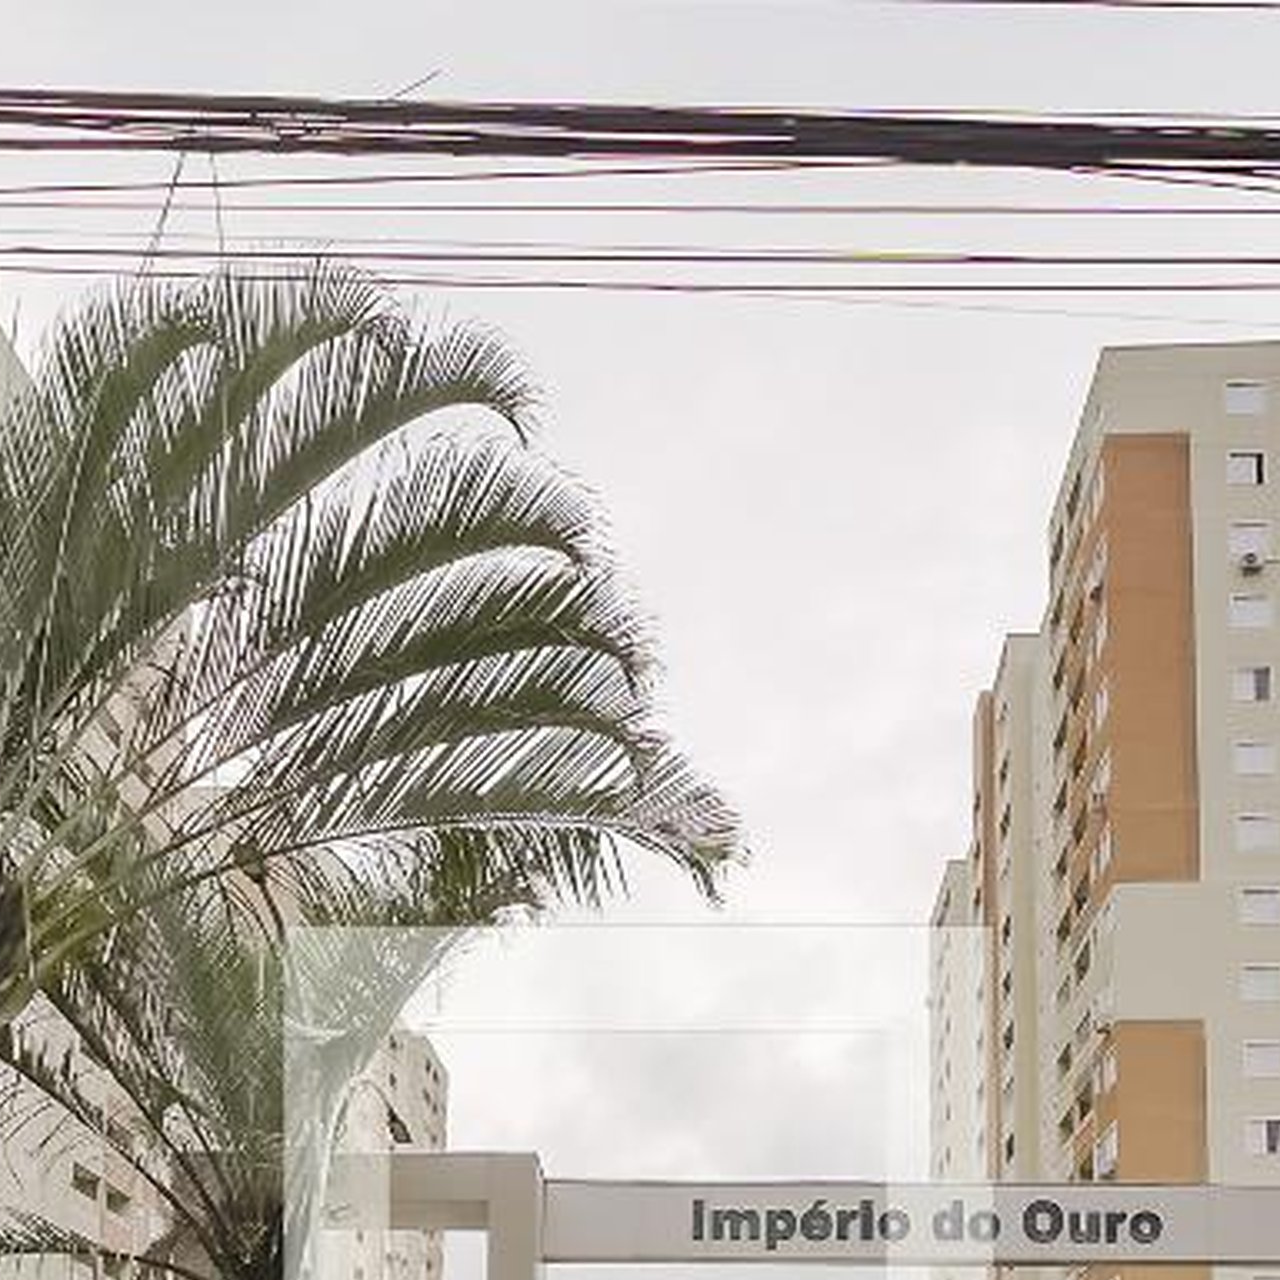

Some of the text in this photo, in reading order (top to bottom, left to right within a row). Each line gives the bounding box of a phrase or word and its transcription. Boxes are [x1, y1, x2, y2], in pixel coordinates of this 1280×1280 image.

[692, 1198, 1165, 1250] Império do Ouro
